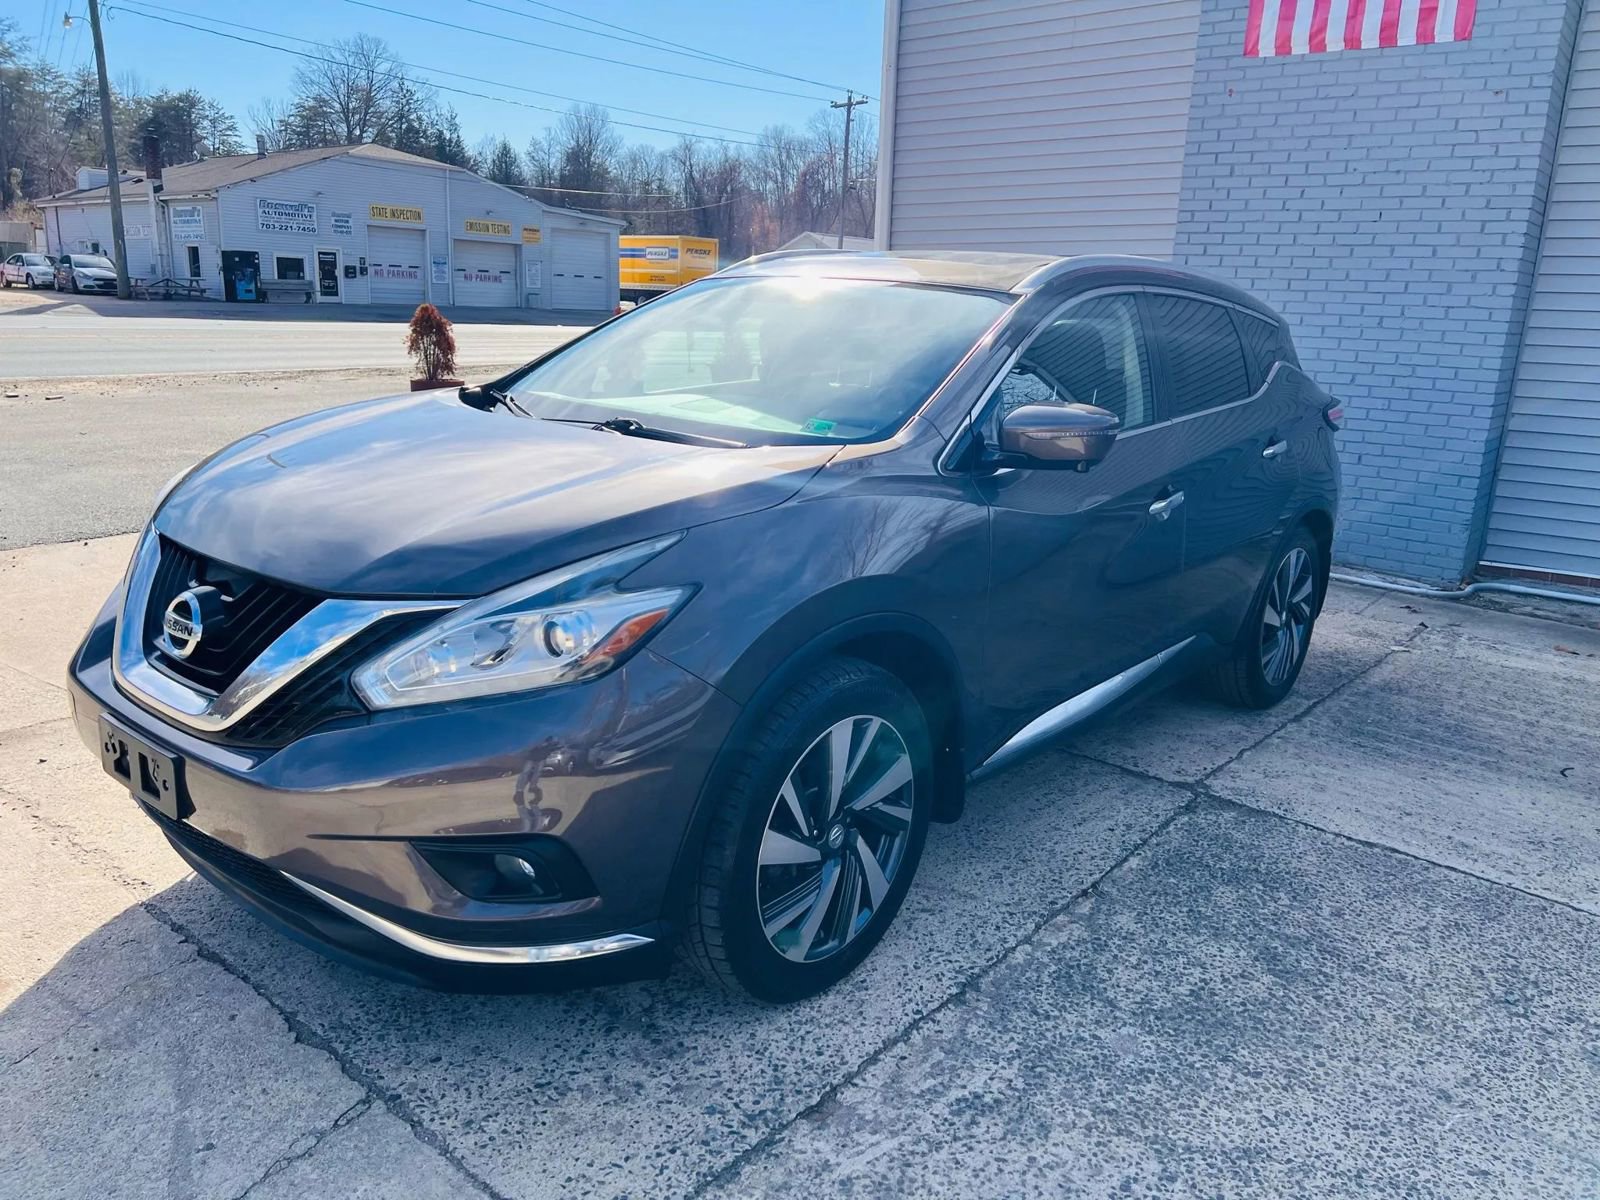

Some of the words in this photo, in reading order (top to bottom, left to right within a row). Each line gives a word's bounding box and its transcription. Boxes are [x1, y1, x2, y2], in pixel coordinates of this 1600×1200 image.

[261, 210, 313, 219] AUTOMOTIVE
[371, 206, 388, 218] STATE
[389, 208, 422, 221] INSPECTION
[260, 223, 316, 233] 703-221-7450
[465, 221, 490, 233] EMISSION
[491, 223, 511, 235] TESTING
[685, 248, 712, 256] PENSKE
[374, 269, 384, 277] NO
[387, 269, 418, 280] PARKING
[463, 273, 473, 282] NO
[475, 273, 503, 284] PARKING
